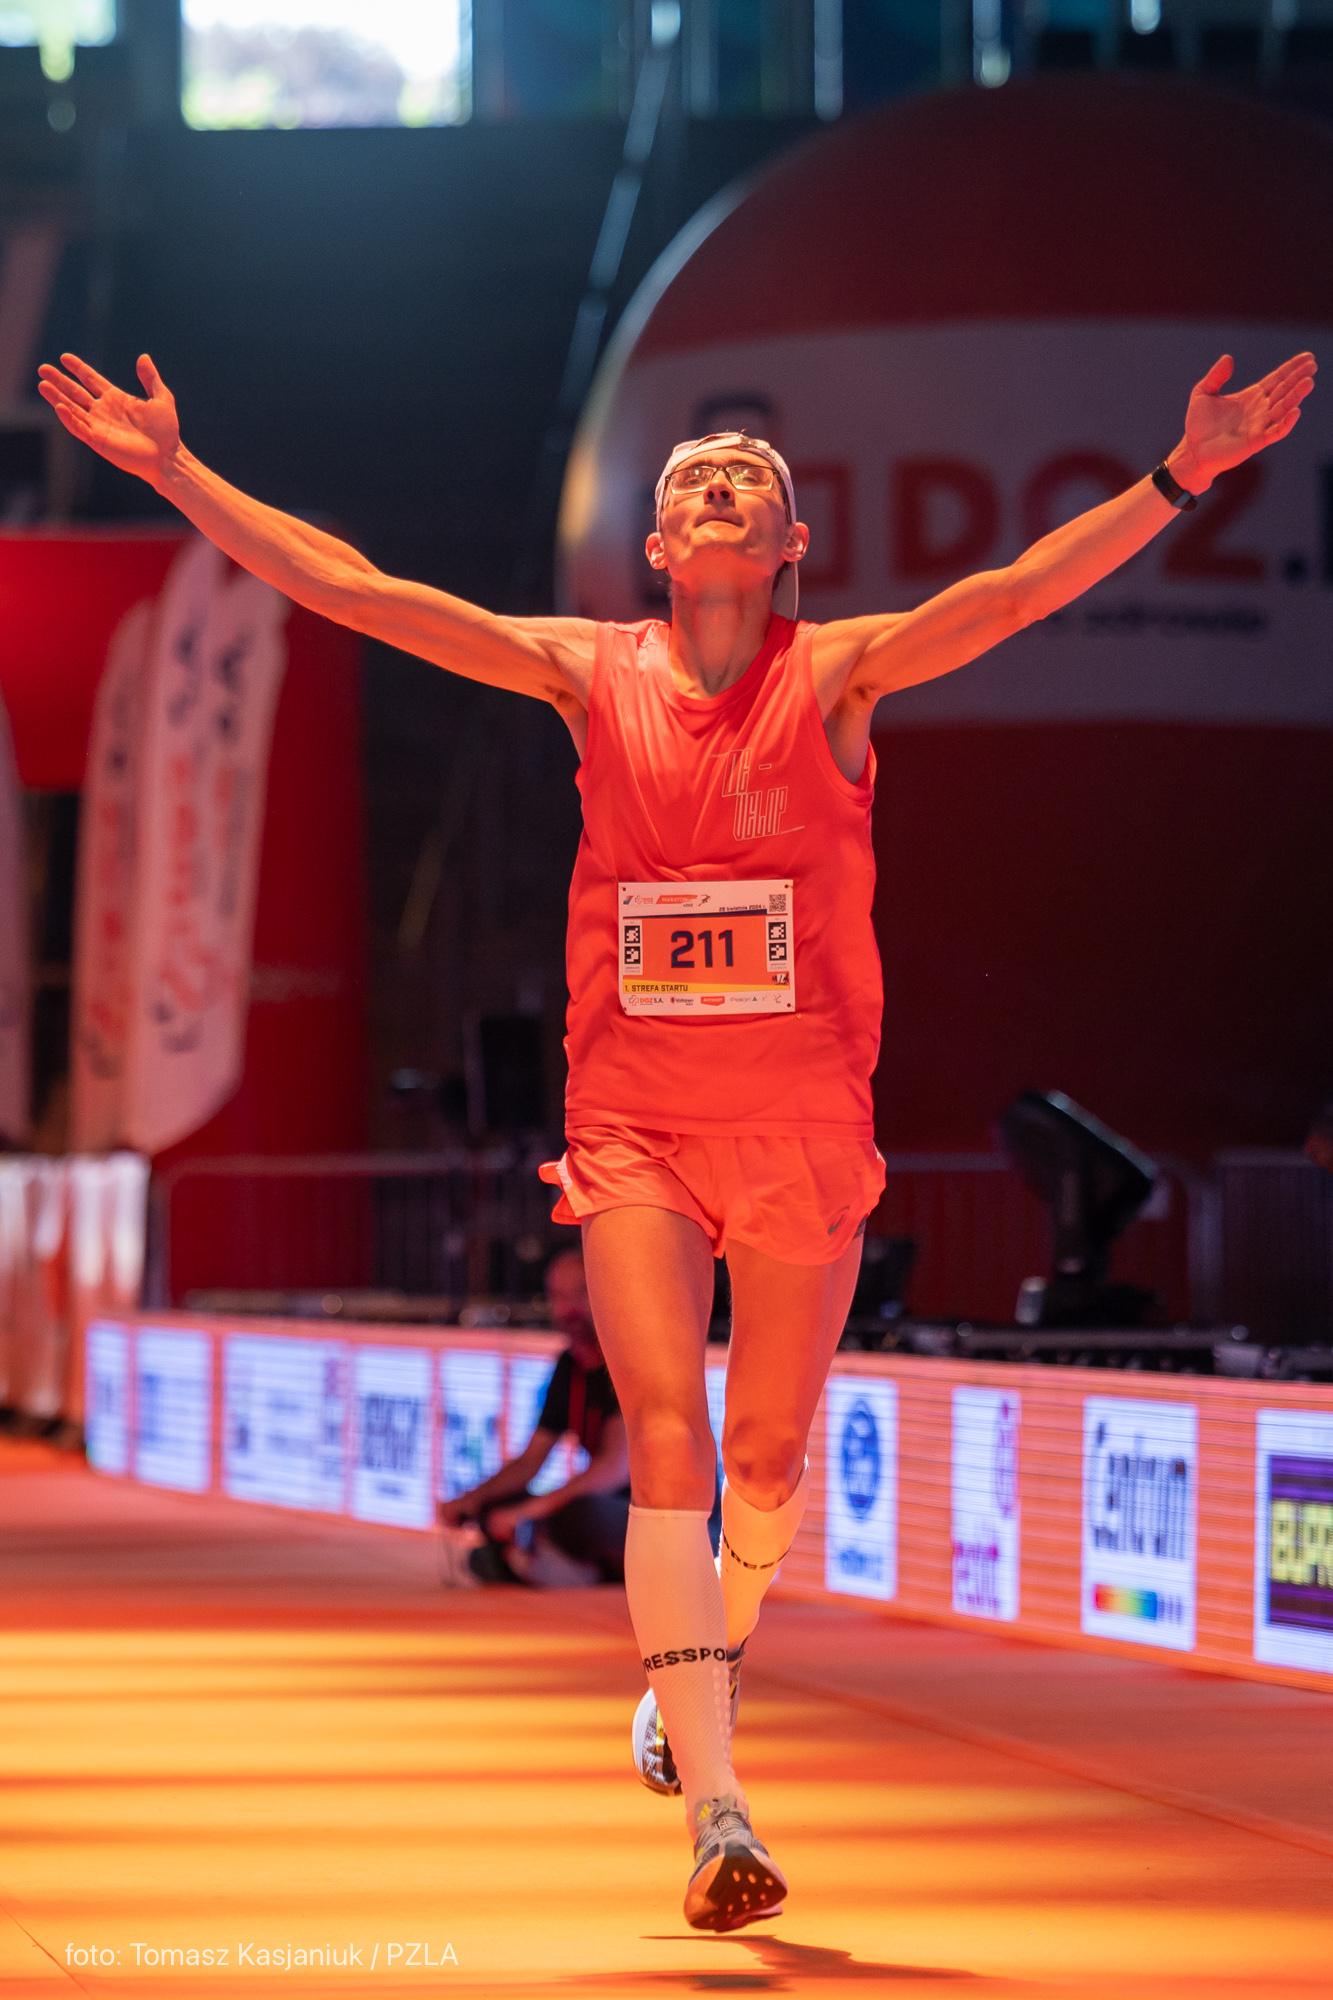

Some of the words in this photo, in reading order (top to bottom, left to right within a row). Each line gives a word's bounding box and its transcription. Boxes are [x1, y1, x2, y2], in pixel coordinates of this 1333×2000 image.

[889, 445, 1333, 586] DOZ.
[671, 929, 734, 968] 211
[631, 984, 659, 992] STREFA
[661, 984, 689, 992] STARTU
[642, 1647, 728, 1673] RESSPO
